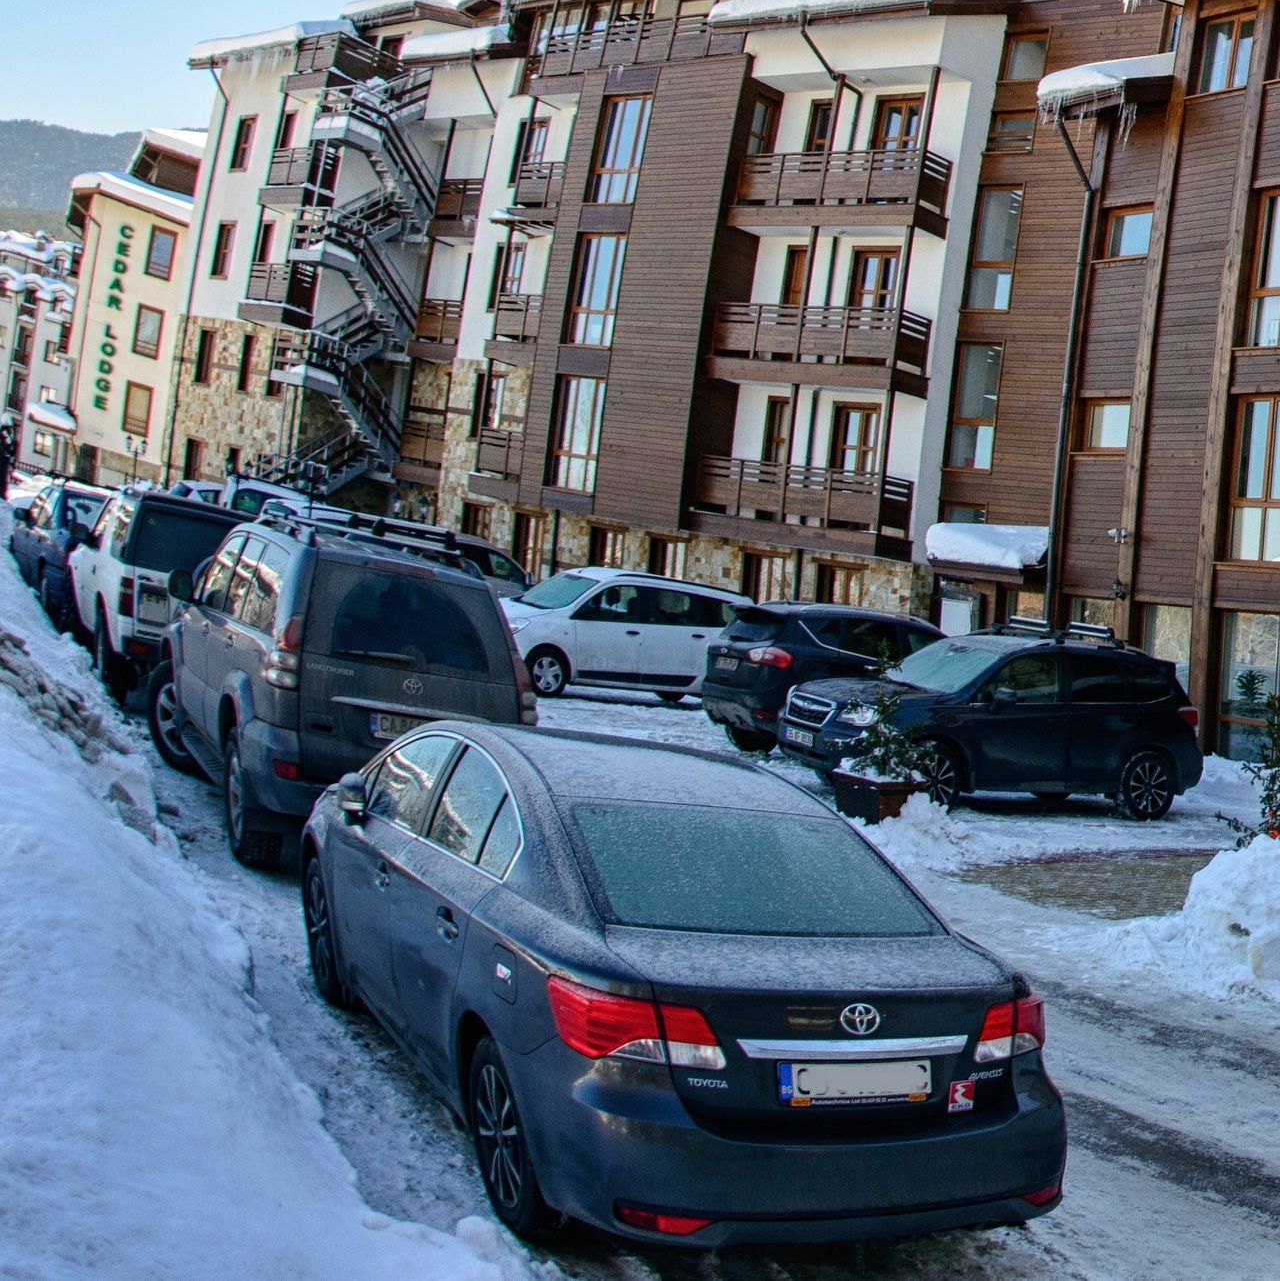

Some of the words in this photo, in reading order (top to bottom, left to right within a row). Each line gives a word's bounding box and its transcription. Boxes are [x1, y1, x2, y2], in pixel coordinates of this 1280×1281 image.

[106, 223, 135, 312] CEDAR
[93, 324, 118, 412] LODGE
[687, 1077, 729, 1089] TOYOTA
[968, 1068, 1004, 1081] AVENSIS
[781, 1085, 793, 1094] BG
